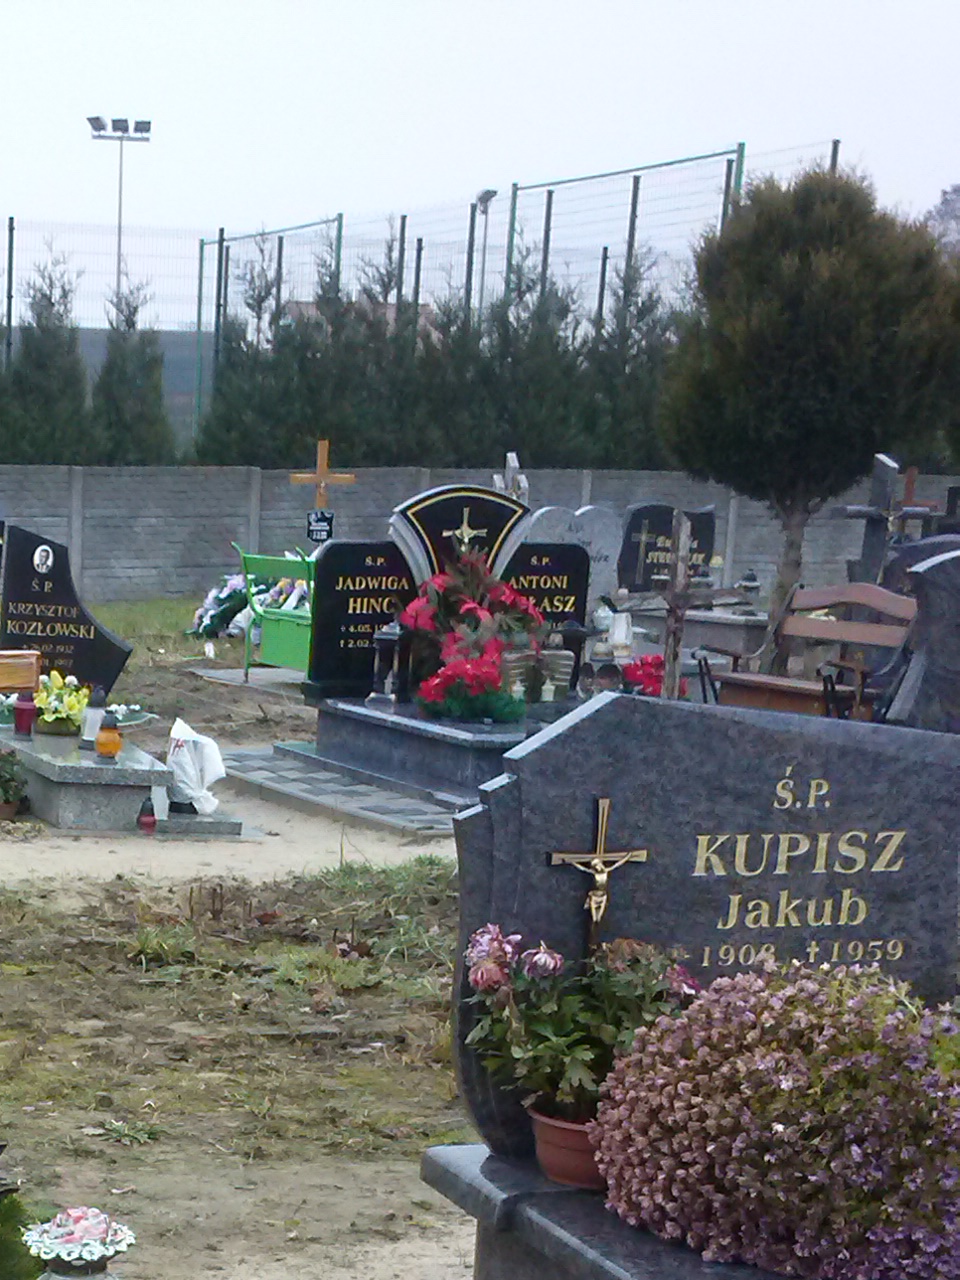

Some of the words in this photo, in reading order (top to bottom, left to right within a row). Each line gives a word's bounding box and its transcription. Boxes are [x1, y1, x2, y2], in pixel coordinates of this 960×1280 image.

[335, 575, 409, 590] JADWIGA
[508, 575, 568, 589] ANTONI
[6, 619, 96, 640] KOZŁOWSKI
[691, 829, 907, 877] KUPISZ
[717, 888, 869, 930] Jakub
